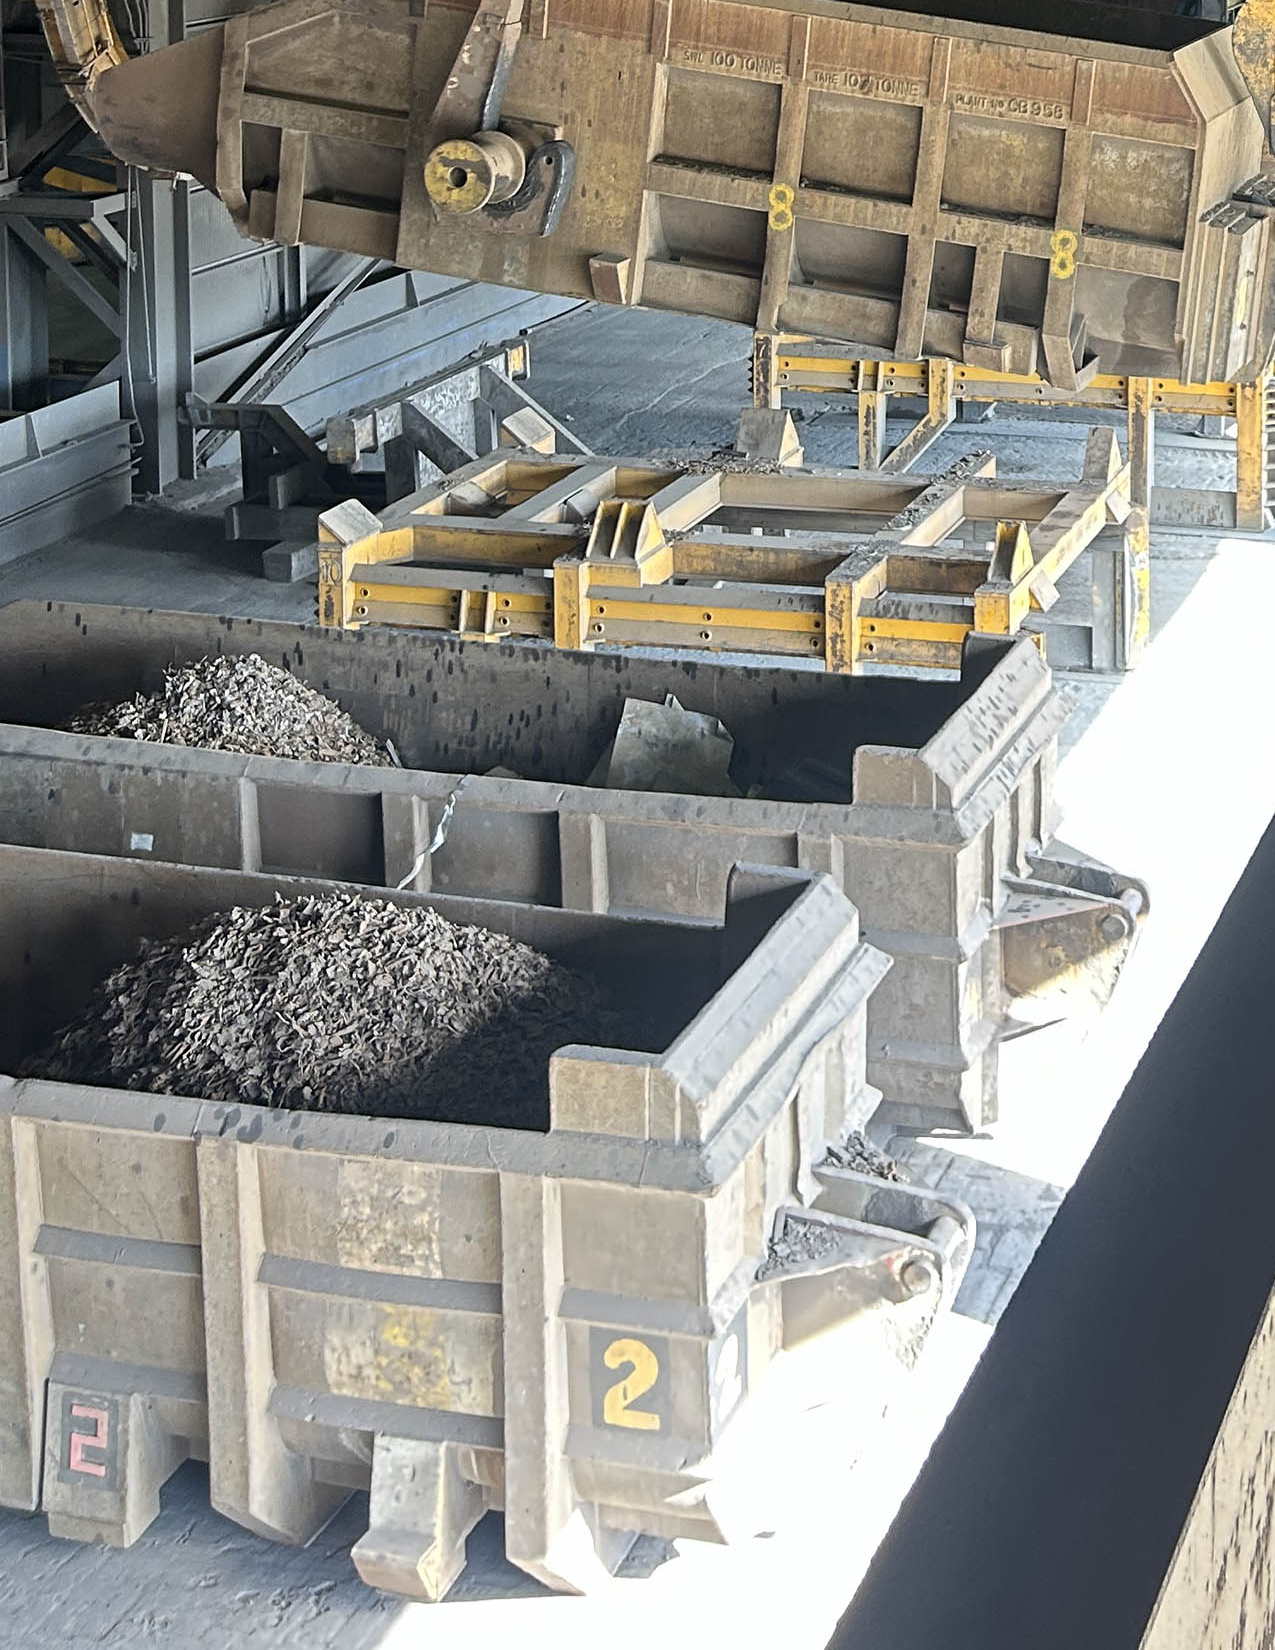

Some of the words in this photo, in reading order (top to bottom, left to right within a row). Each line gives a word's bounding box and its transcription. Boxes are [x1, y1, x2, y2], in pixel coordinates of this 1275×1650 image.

[683, 50, 704, 64] SWL
[711, 51, 737, 68] 100
[740, 55, 785, 77] TONNE
[814, 70, 840, 85] TARE
[874, 77, 920, 97] TONNE
[768, 182, 795, 231] 8
[1050, 230, 1078, 279] 8
[603, 1338, 661, 1430] 2
[70, 1404, 109, 1477] 2
